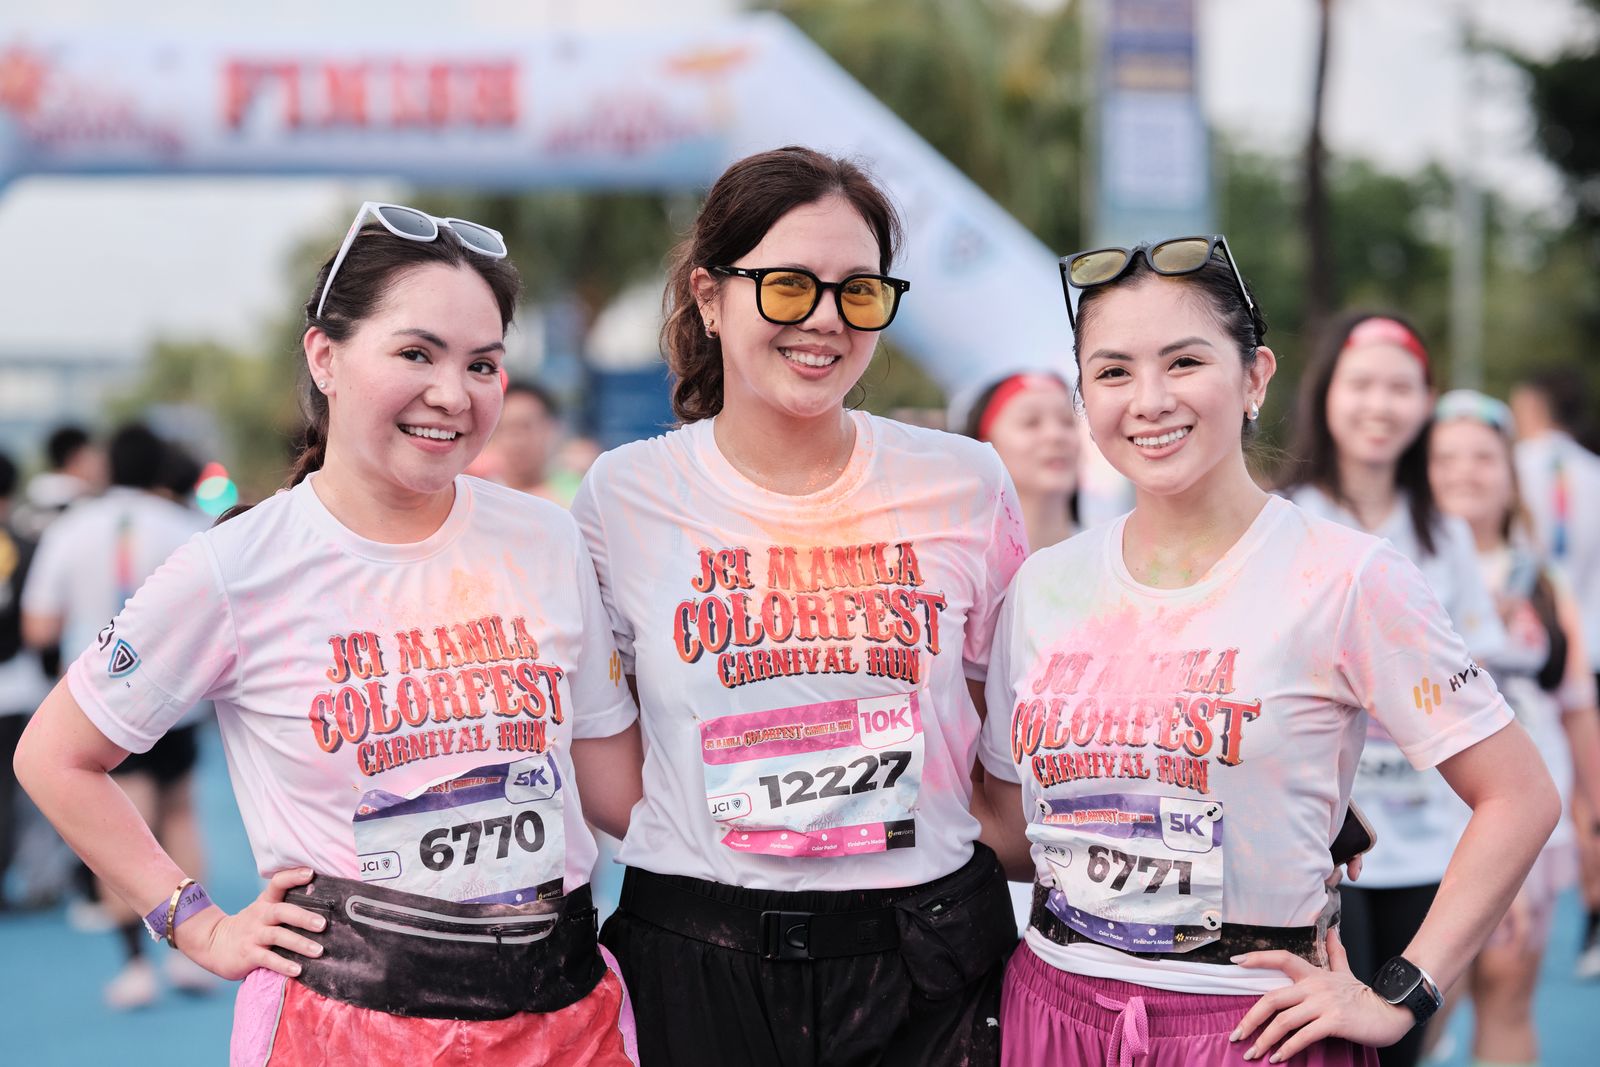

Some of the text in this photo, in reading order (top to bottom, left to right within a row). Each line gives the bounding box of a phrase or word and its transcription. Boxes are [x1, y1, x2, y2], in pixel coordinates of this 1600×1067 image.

[691, 541, 926, 593] JCI MANILA
[326, 615, 540, 684] JCI MANILA
[673, 587, 948, 664] COLORFEST
[717, 646, 921, 689] CARNIVAL RUN
[308, 662, 565, 753] COLORFEST
[860, 706, 911, 735] 10K
[1011, 694, 1262, 767] COLORFEST
[357, 719, 548, 777] CARNIVAL RUN
[513, 766, 549, 788] 5K
[758, 751, 912, 810] 12227
[1032, 752, 1211, 795] CARNIVAL RUN
[712, 802, 729, 814] JCI
[1169, 812, 1205, 837] 5K
[419, 810, 545, 872] 6770
[847, 840, 871, 848] Finisher's
[361, 861, 379, 872] JCI
[1086, 845, 1192, 895] 6771
